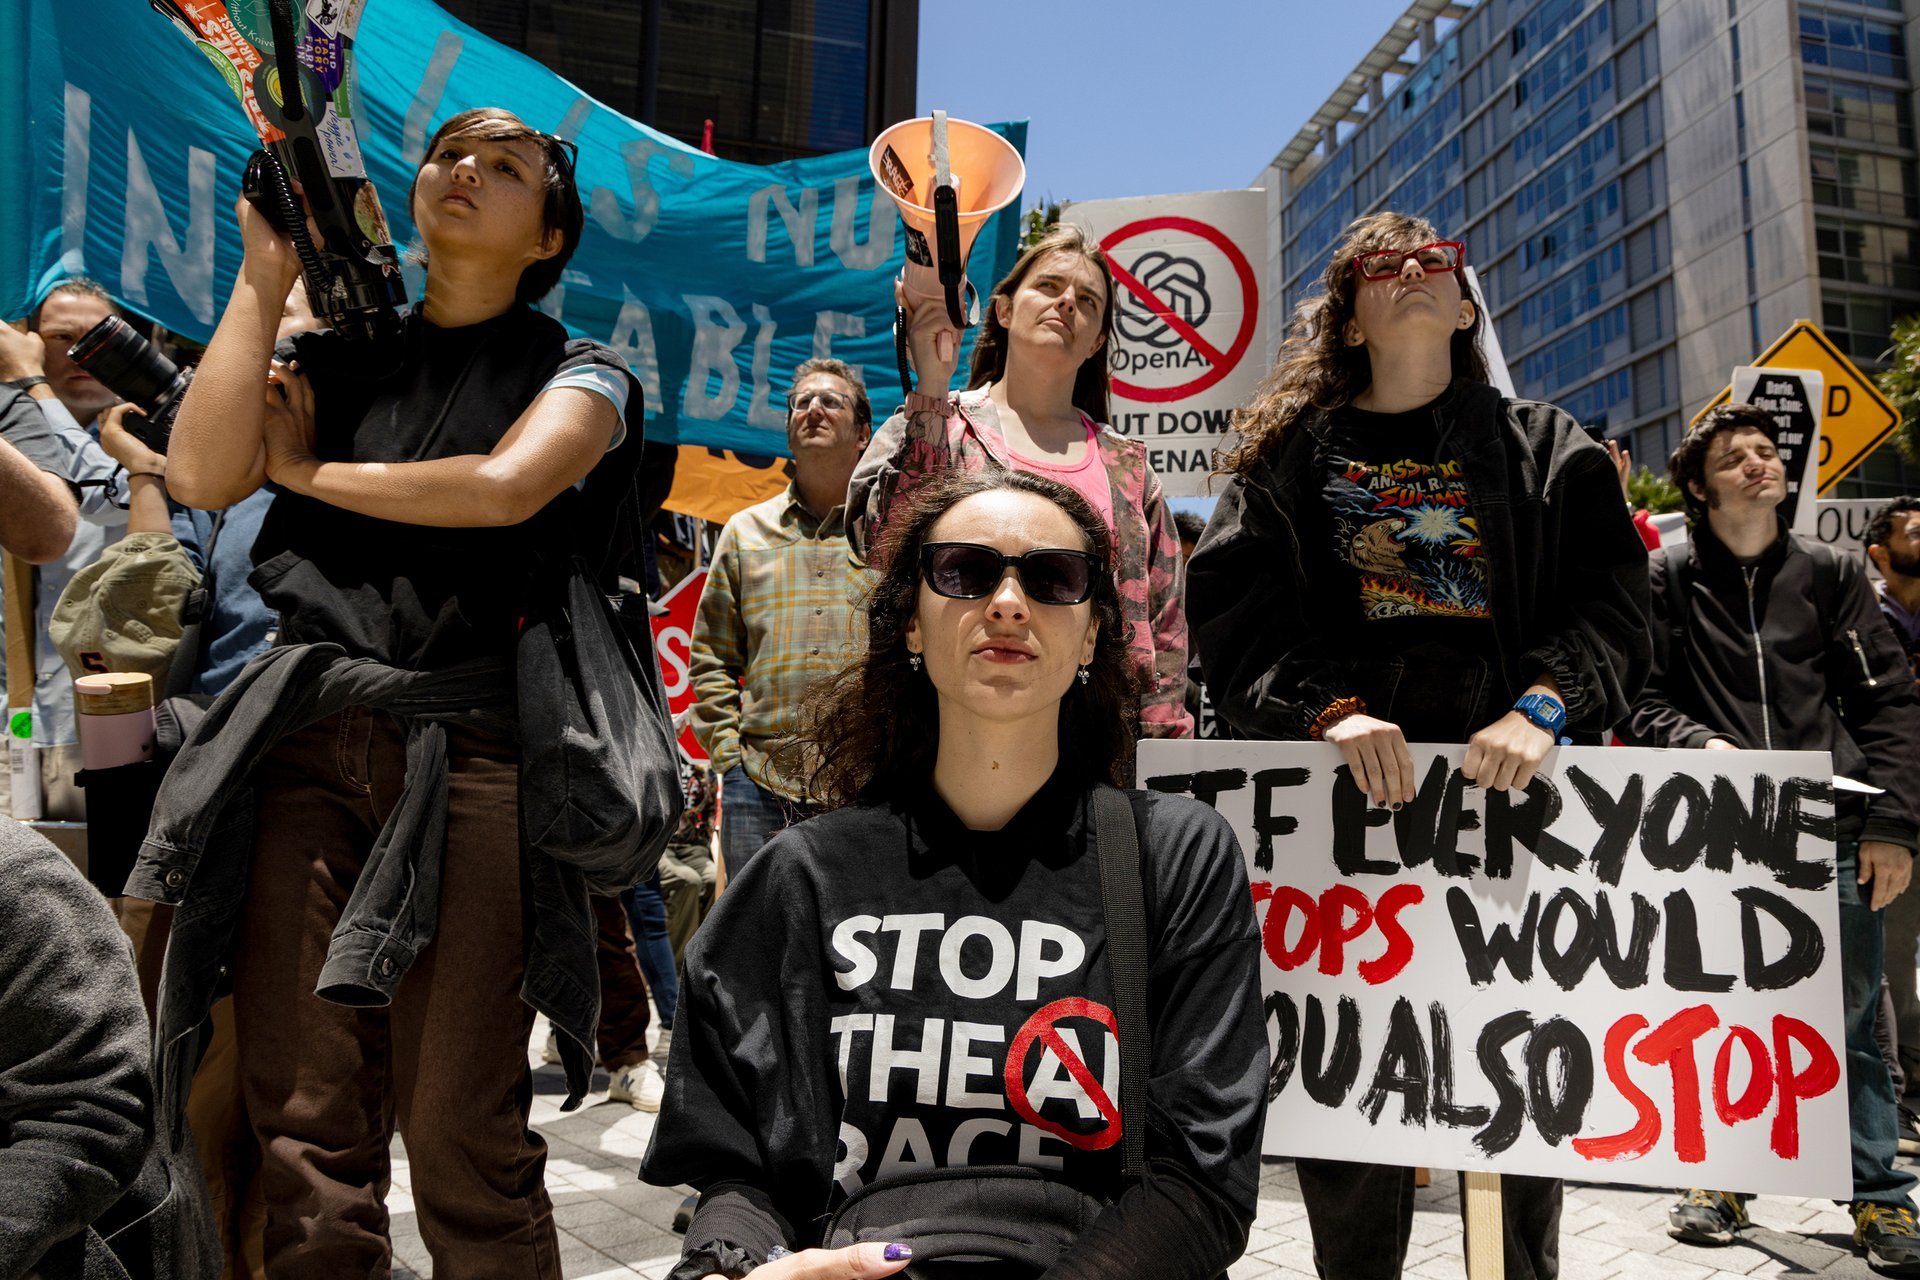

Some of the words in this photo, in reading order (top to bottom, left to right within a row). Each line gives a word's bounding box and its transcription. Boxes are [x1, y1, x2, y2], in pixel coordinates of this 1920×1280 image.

[248, 30, 275, 48] Knive
[314, 36, 323, 74] TORY
[328, 43, 338, 69] END
[1112, 411, 1150, 436] UT
[1158, 409, 1234, 435] DOW
[1149, 447, 1220, 474] ENA
[1367, 476, 1426, 493] ANIAL
[1332, 754, 1836, 891] EVERYONE
[1250, 881, 1425, 985] OPS
[1447, 886, 1826, 993] WOULD
[832, 913, 1085, 1000] STOP
[830, 1013, 1006, 1110] THE
[1263, 991, 1361, 1109] OU
[1357, 995, 1594, 1160] ALSO
[1571, 1003, 1841, 1164] STOP
